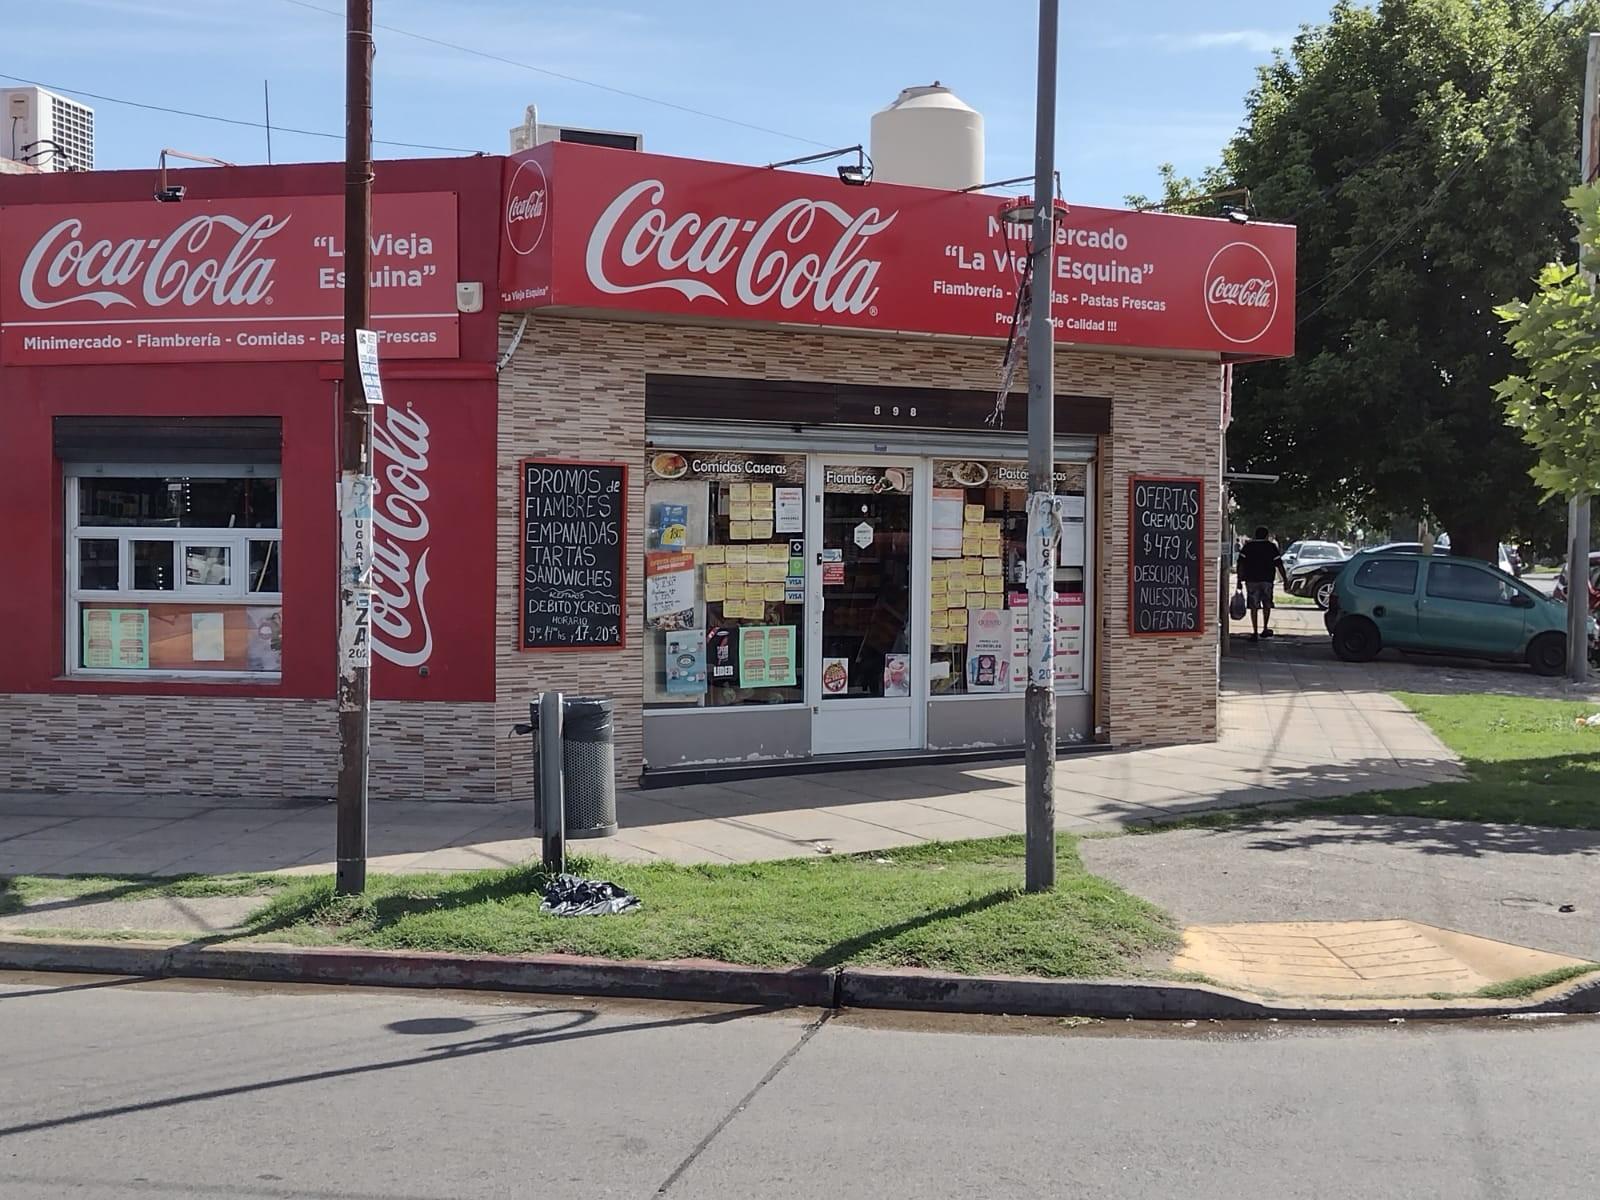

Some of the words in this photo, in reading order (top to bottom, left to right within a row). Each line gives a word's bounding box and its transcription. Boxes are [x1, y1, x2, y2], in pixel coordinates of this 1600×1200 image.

[509, 190, 545, 223] Coca-Cola
[988, 215, 1128, 250] Miniercado
[313, 236, 346, 257] “L
[370, 233, 433, 259] Vieja
[585, 179, 898, 316] Coca-Cola
[20, 214, 292, 309] Coca-Cola
[945, 245, 985, 271] “La
[1057, 256, 1154, 286] Esquina”
[319, 265, 437, 289] Esuina”
[933, 280, 1003, 299] Fiambrería
[1208, 275, 1274, 308] Coca-Cola
[1081, 293, 1119, 309] Pastas
[1122, 295, 1167, 311] Frescas
[1066, 317, 1105, 331] Calidad
[24, 335, 122, 351] Minimercado
[137, 332, 222, 349] Fiambrería
[237, 330, 305, 347] Comidas
[376, 329, 437, 344] Frescas
[692, 459, 742, 473] Comidas
[744, 461, 787, 475] Caseras
[826, 471, 877, 485] Fiambres
[998, 466, 1029, 481] Pasta
[528, 468, 601, 494] PROMOS
[606, 480, 620, 493] de
[526, 494, 612, 519] FIAMBRES
[1135, 485, 1199, 516] OFERTAS
[1142, 510, 1195, 531] CREMOSO
[526, 521, 619, 546] EMPANADAS
[531, 545, 596, 567] TARTAS
[525, 564, 613, 588] SANDWICHES
[1134, 564, 1190, 586] DESCUBRA
[528, 599, 572, 615] DEBITO
[1140, 586, 1198, 609] NUESTRAS
[551, 615, 588, 626] HORARIO
[1140, 609, 1195, 630] OFERTAS
